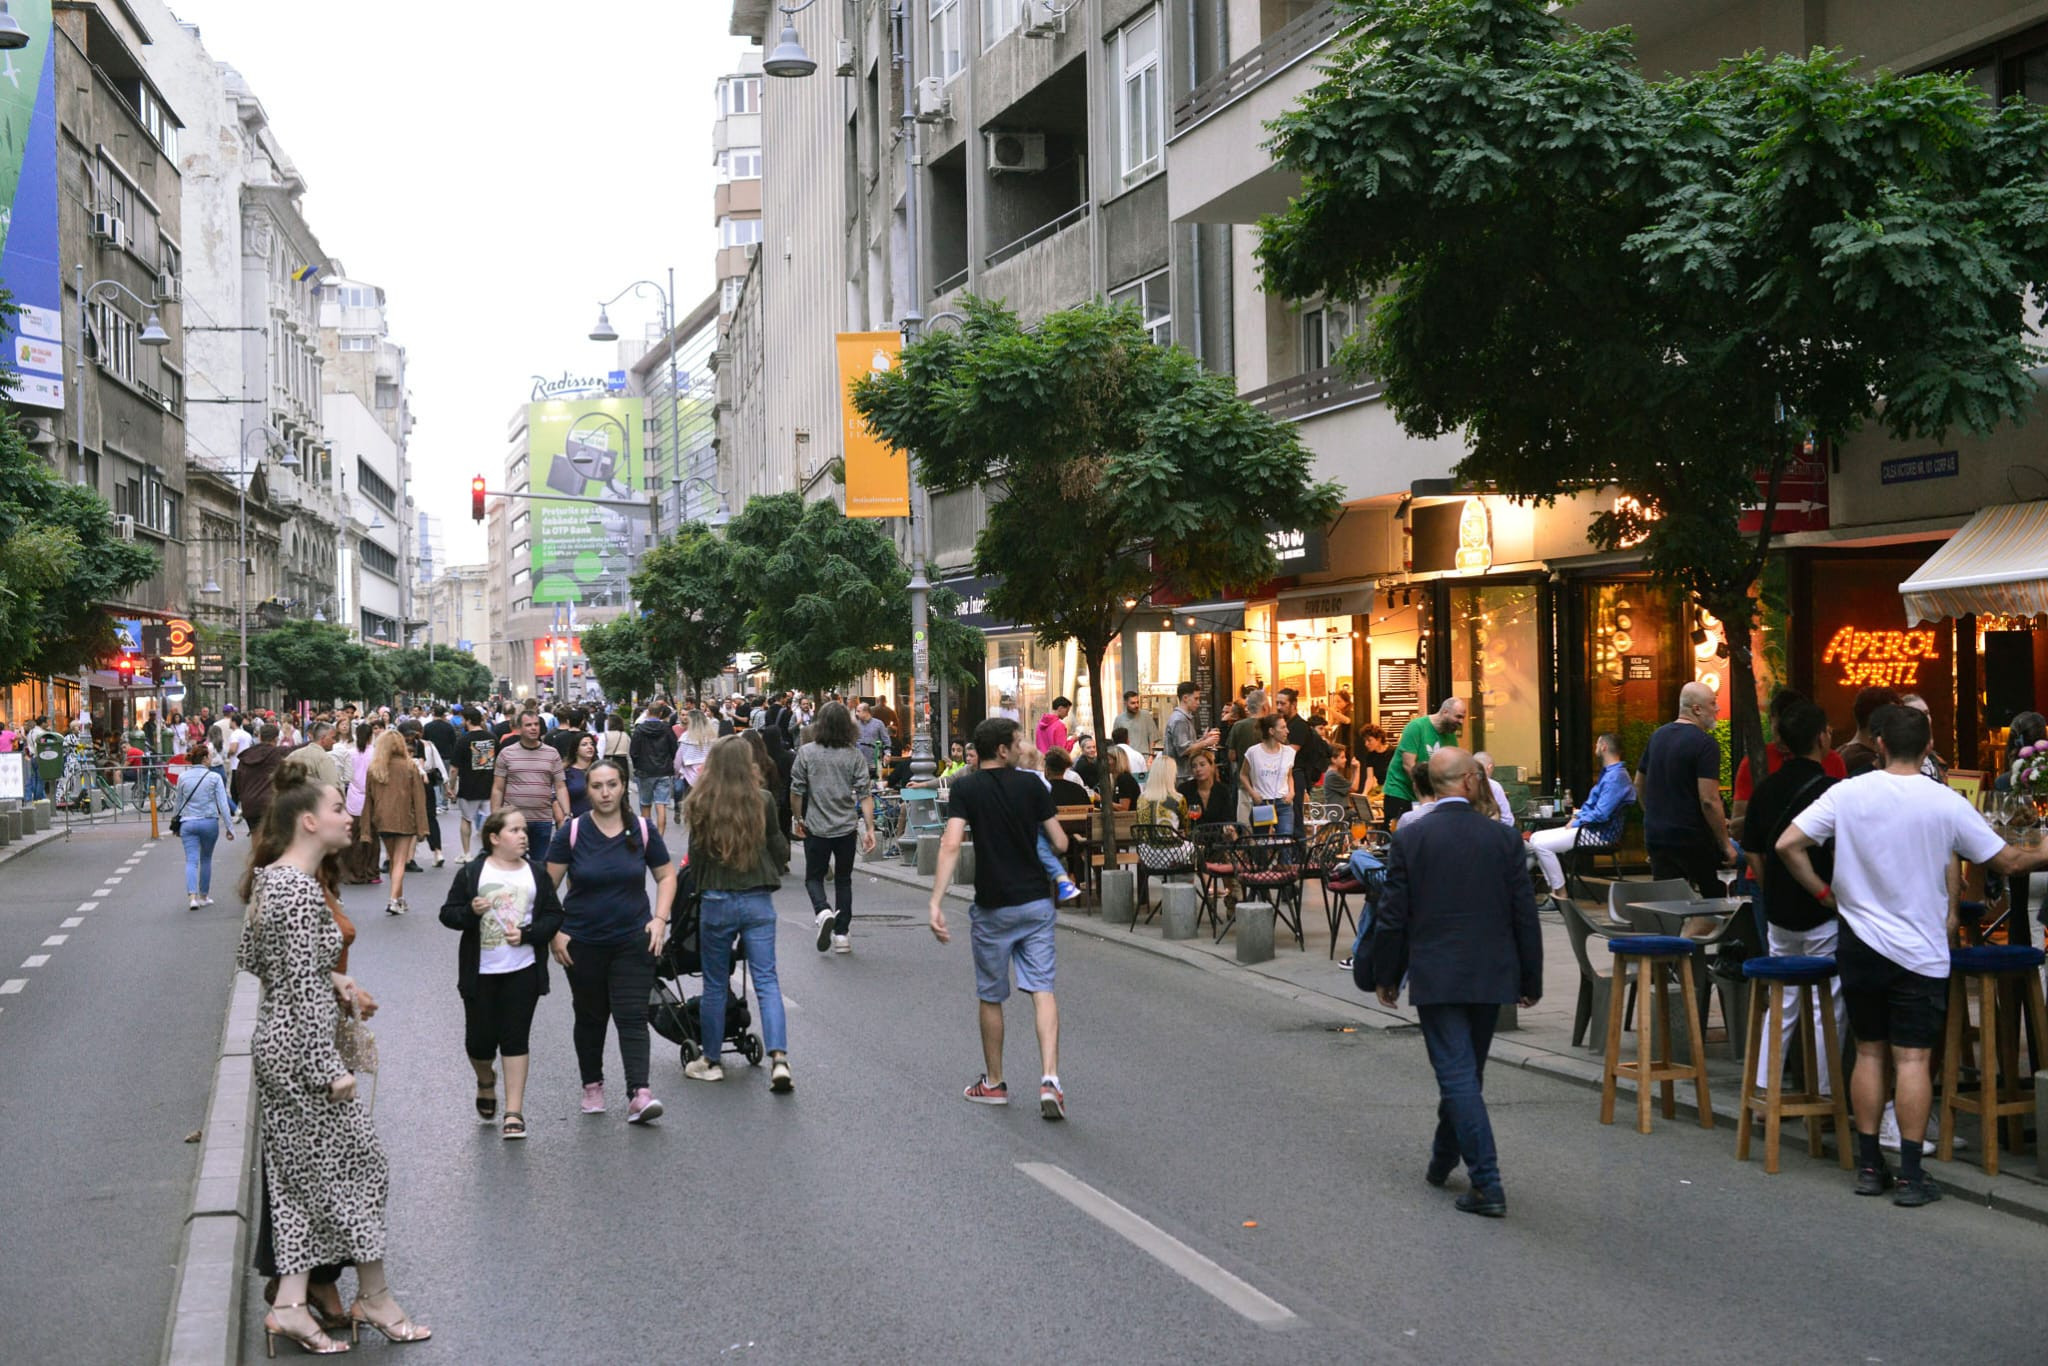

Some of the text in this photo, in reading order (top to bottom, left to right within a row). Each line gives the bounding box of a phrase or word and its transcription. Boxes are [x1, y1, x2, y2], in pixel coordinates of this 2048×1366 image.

[531, 370, 607, 401] Radisson
[552, 527, 569, 535] OTP
[570, 526, 592, 535] Bank
[1822, 626, 1939, 663] APEROL
[1838, 661, 1919, 687] SPRITZ
